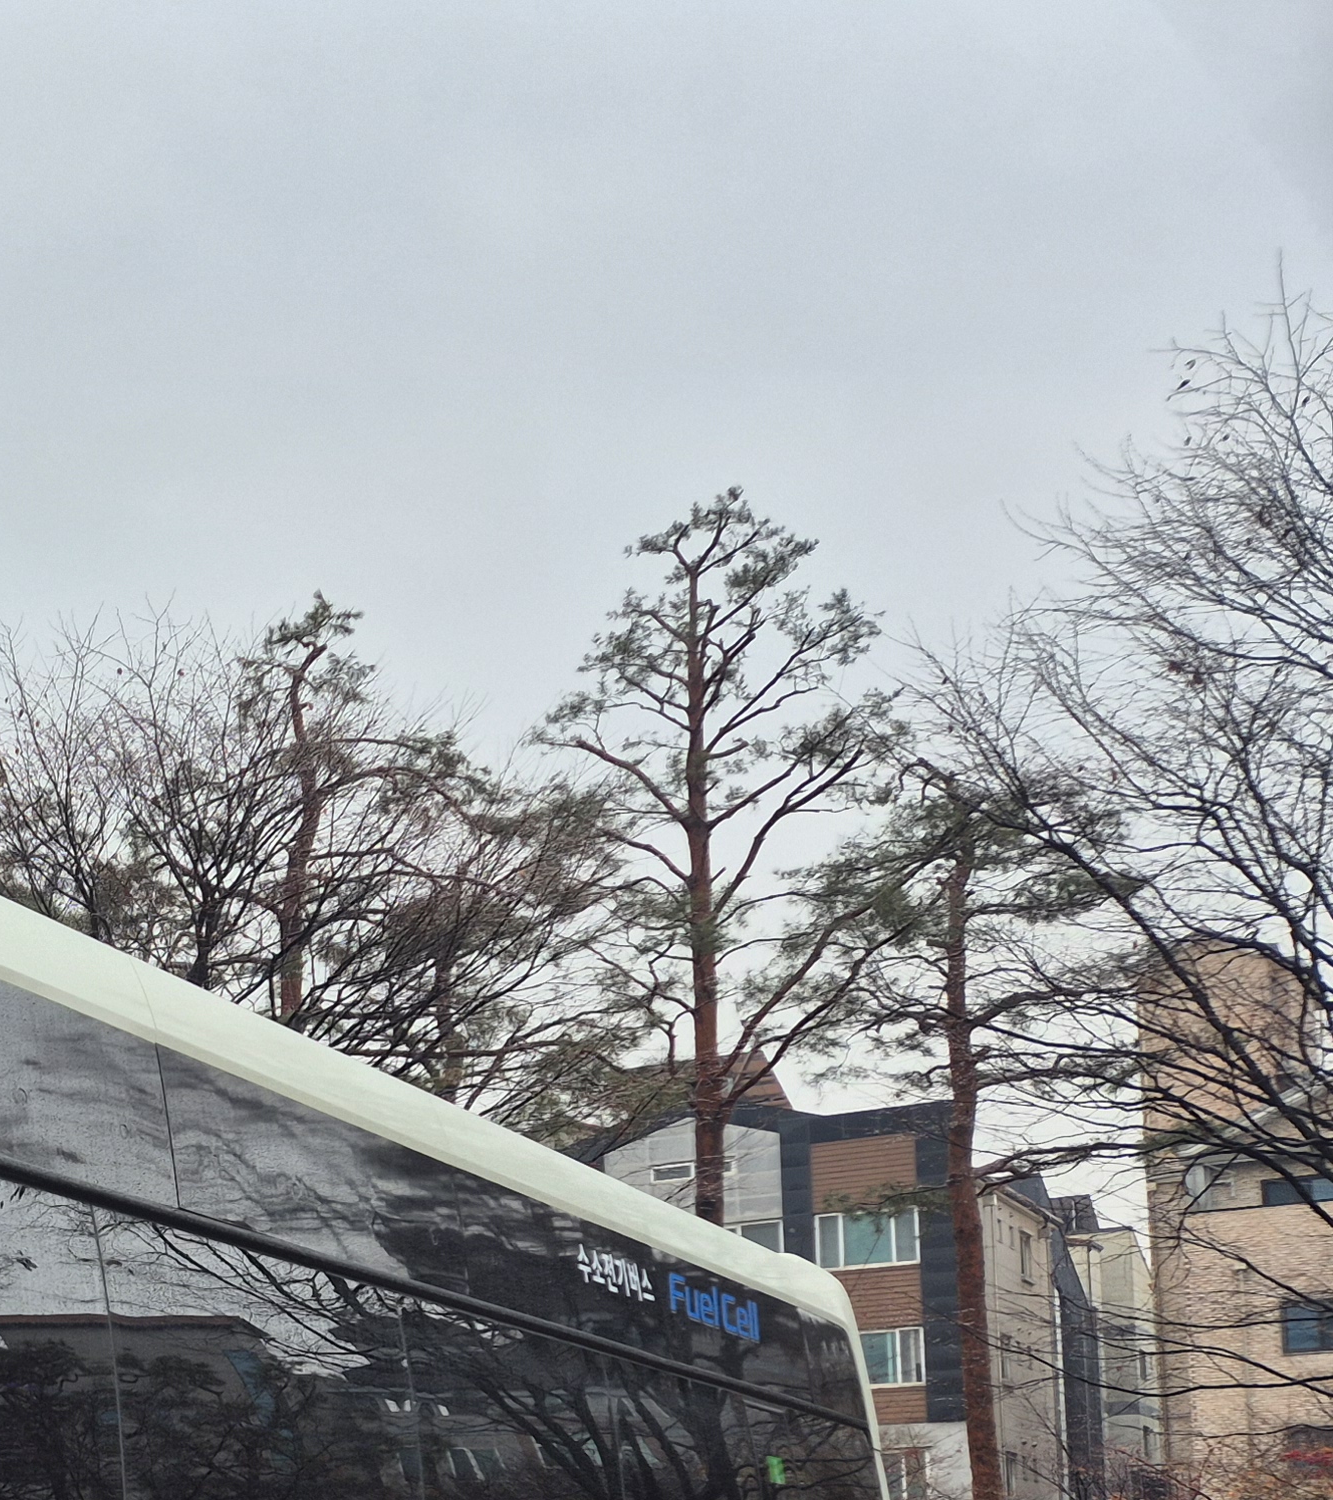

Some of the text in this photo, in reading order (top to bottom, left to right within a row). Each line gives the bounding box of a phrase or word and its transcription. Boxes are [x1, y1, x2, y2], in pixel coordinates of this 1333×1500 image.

[577, 1243, 656, 1302] 수소전기버스
[669, 1272, 761, 1343] Fuel Cell
